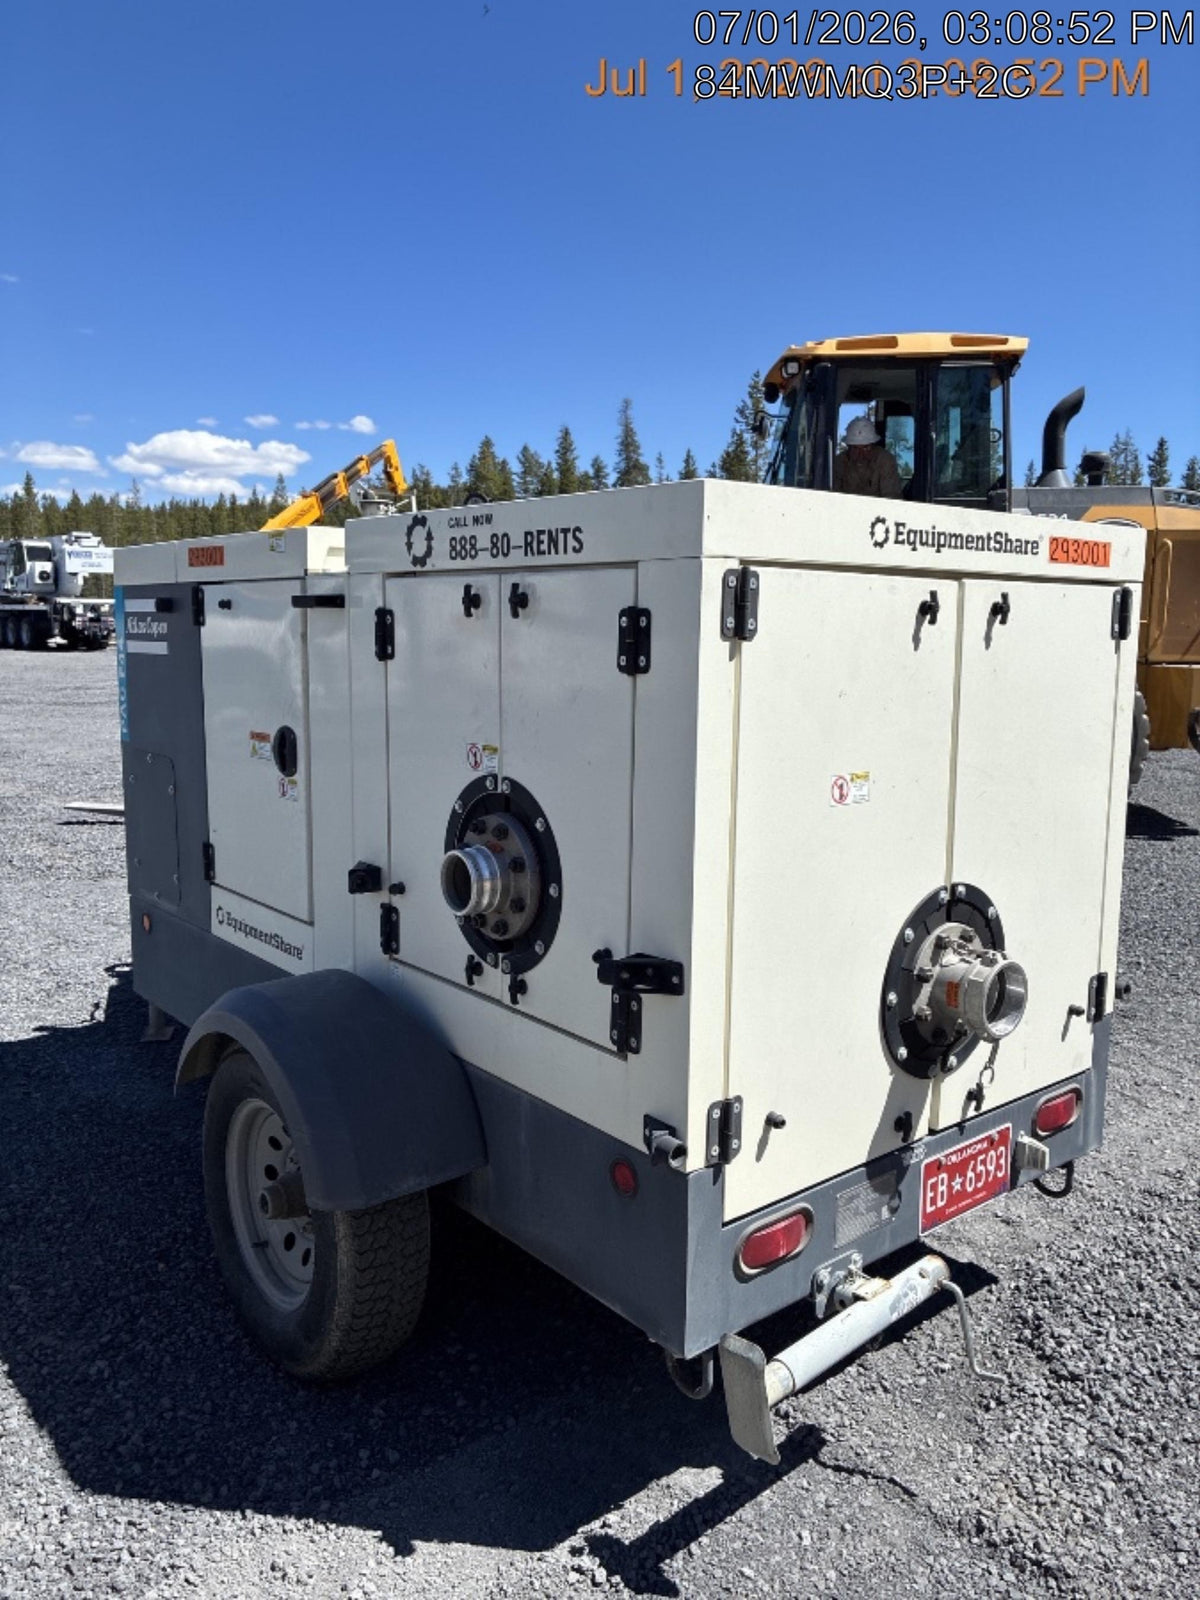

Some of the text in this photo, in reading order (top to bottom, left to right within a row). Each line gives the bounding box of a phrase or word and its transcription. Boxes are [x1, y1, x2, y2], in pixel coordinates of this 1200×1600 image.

[449, 513, 493, 528] CALL NOW
[449, 526, 584, 560] 888-80-RENTS
[893, 521, 1040, 556] EquipmentShare
[1049, 536, 1109, 566] 293001
[925, 1172, 948, 1214] EB
[966, 1145, 1006, 1193] 6593
